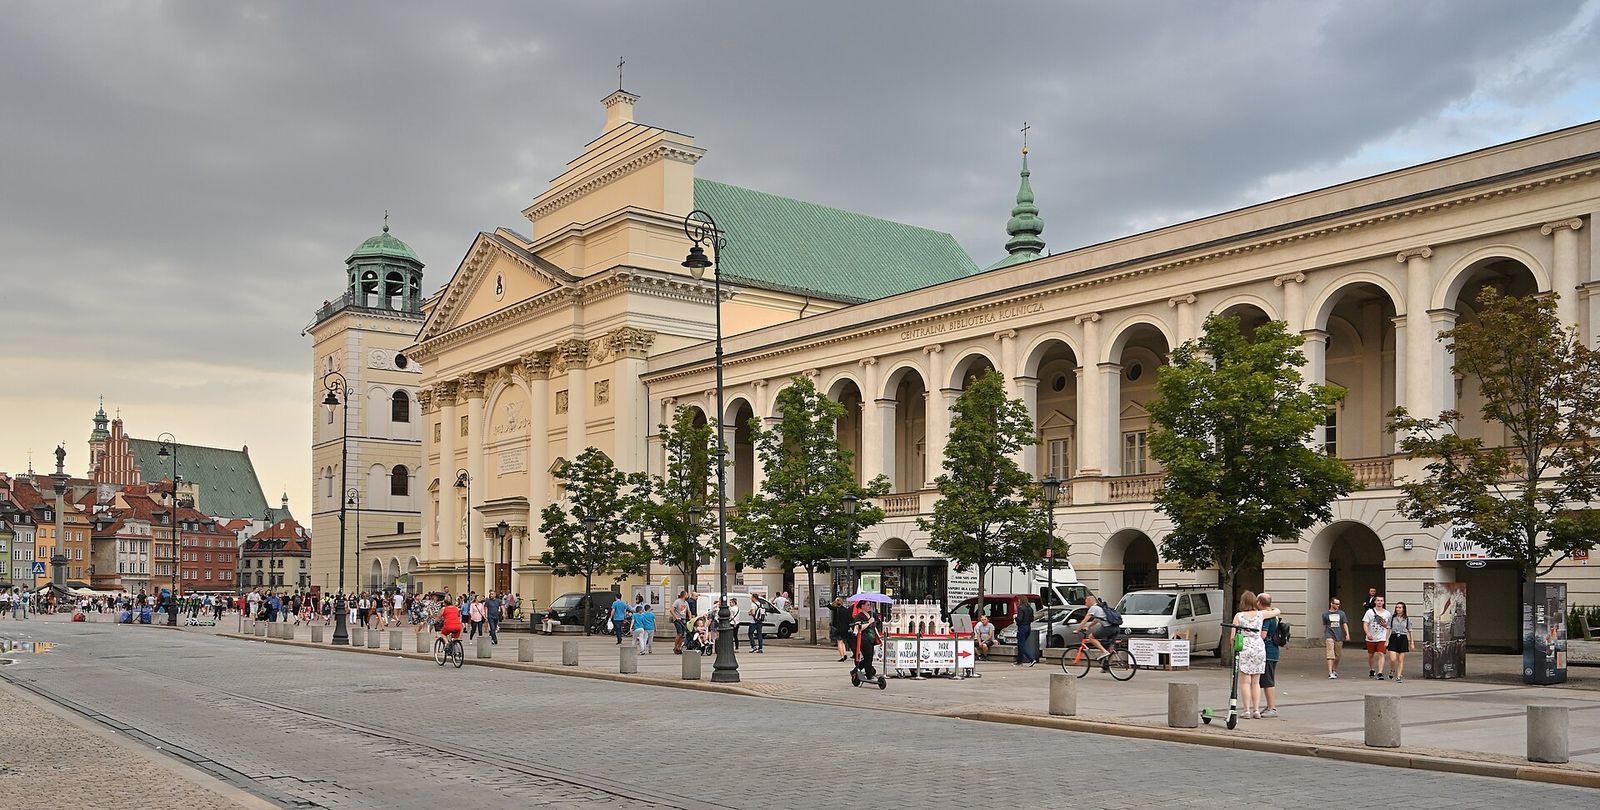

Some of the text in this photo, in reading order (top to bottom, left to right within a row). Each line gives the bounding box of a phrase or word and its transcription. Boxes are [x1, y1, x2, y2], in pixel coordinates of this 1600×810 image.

[901, 302, 1044, 340] CENTRALNA BIBLIOTEKA ROLNICZA
[1443, 541, 1474, 552] WARSAW
[934, 650, 953, 658] MINIATUR
